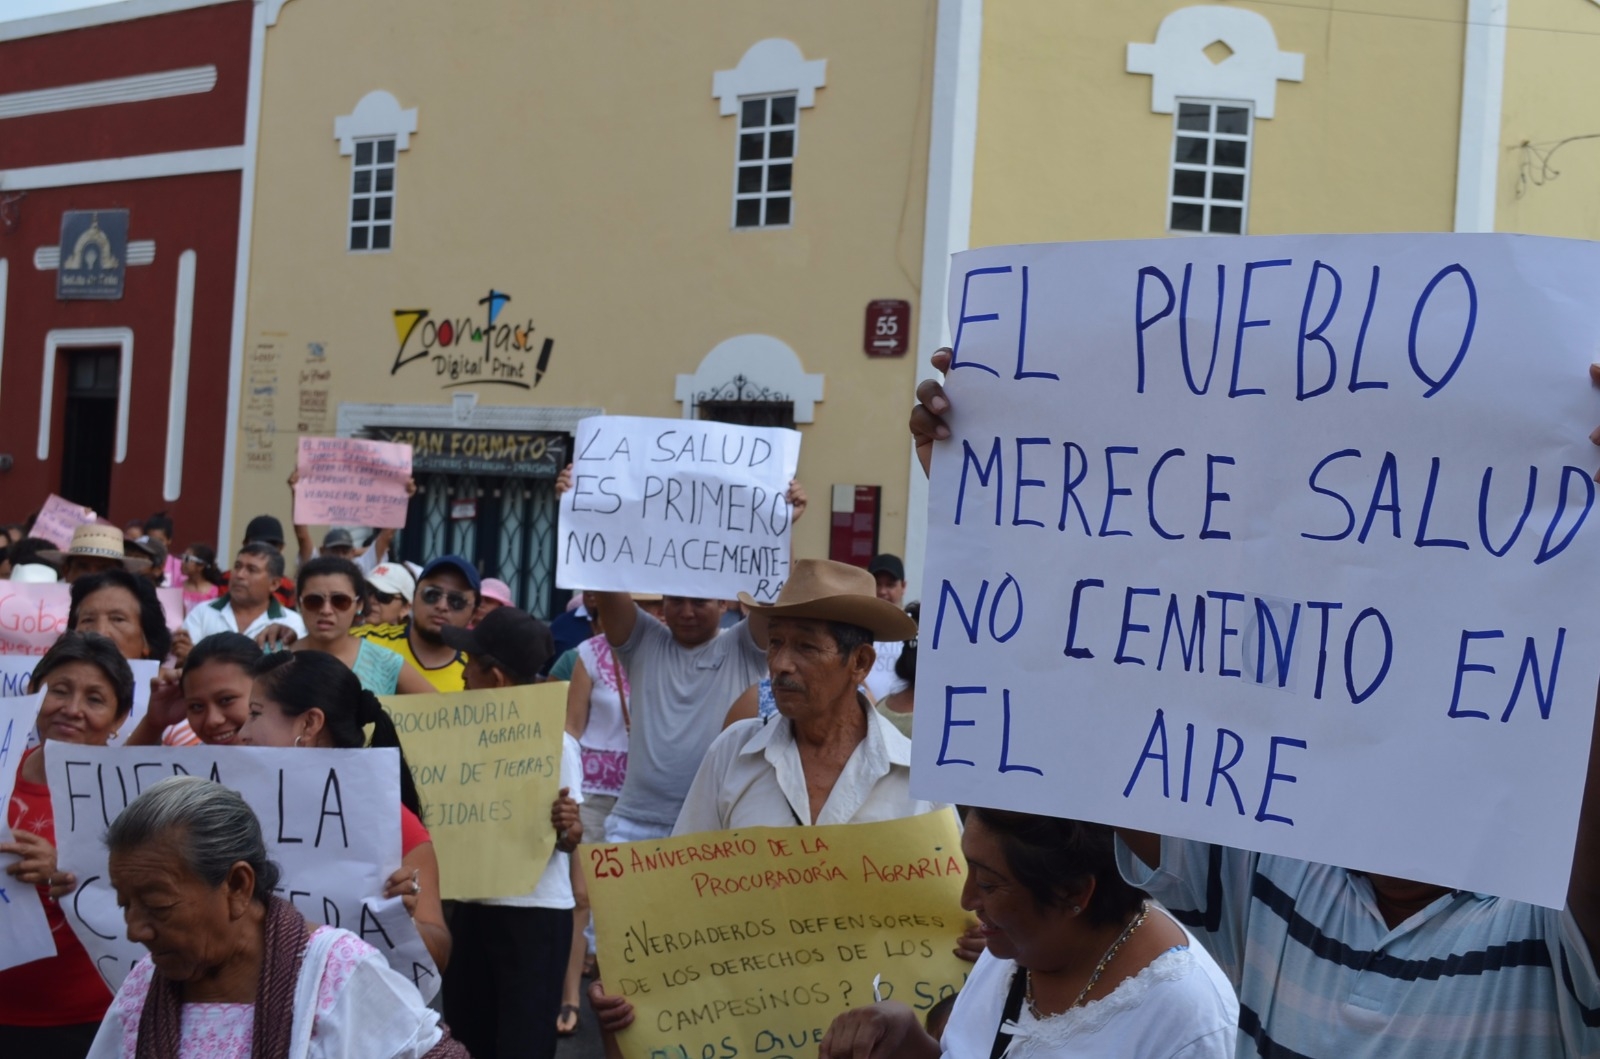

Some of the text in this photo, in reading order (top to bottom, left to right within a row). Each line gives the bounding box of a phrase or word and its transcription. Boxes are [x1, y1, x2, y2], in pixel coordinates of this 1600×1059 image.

[876, 315, 898, 335] 55
[951, 259, 1478, 400] EL PUEBLO
[431, 354, 525, 380] Digital Print
[451, 432, 547, 461] FORMATO
[578, 428, 772, 467] LA SALUD
[571, 475, 789, 537] ES PRIMERO
[954, 436, 1597, 565] MERECE SALUD
[566, 530, 606, 564] NO
[613, 536, 634, 563] A
[932, 572, 1567, 723] NO CEMENTO EN
[478, 722, 542, 748] AGRARIA
[460, 762, 487, 785] DE
[494, 755, 555, 779] TIERRAS
[936, 686, 1307, 826] EL AIRE
[277, 767, 348, 848] LA
[422, 800, 513, 828] EJIDALES
[591, 832, 829, 879] 25 ANIVERSARIO DE LA
[862, 846, 962, 883] AGRARIA
[789, 913, 945, 935] DEFENSORES
[619, 939, 933, 997] DE LOS DERECHOS DE LOS
